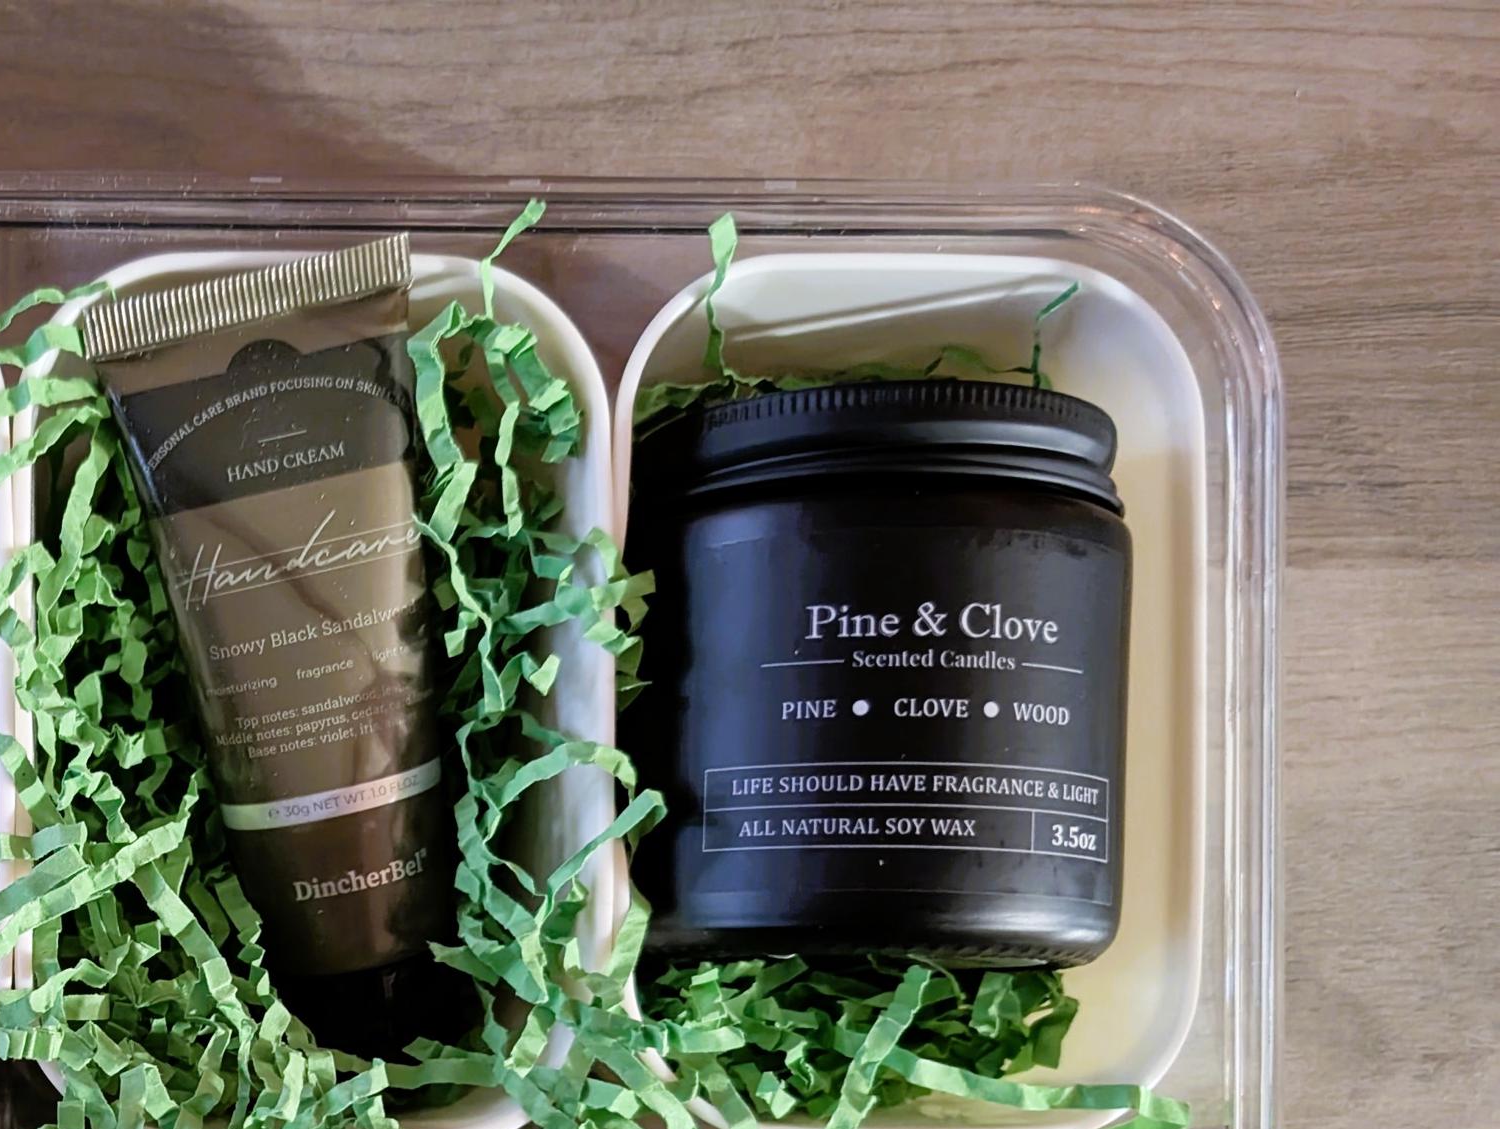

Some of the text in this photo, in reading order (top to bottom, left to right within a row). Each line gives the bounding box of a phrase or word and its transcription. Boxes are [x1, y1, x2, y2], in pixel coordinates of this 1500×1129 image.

[146, 375, 387, 472] ERSONAL CARE BRAND FOCUSING ON SKIN
[227, 441, 345, 482] HAND CREAM
[803, 601, 1059, 644] Pine & Clove
[209, 637, 266, 662] Snowy
[271, 624, 318, 649] Black
[296, 658, 354, 680] fragrance
[851, 649, 1017, 671] Scented Candles
[235, 715, 260, 731] Top
[261, 708, 300, 724] notes:
[781, 698, 1070, 726] PINE CLOVE WOOD
[248, 745, 277, 759] Base
[279, 736, 318, 754] notes:
[319, 725, 357, 744] violet,
[256, 724, 293, 742] notes:
[296, 713, 350, 736] papyrus,
[731, 774, 1099, 806] LIFE SHOULD HAVE FRAGRANCE & LIGHT
[284, 804, 311, 818] 30g
[313, 796, 340, 812] NET
[738, 817, 977, 838] ALL NATURAL SOY WAX
[1051, 822, 1097, 851] 3.5oz
